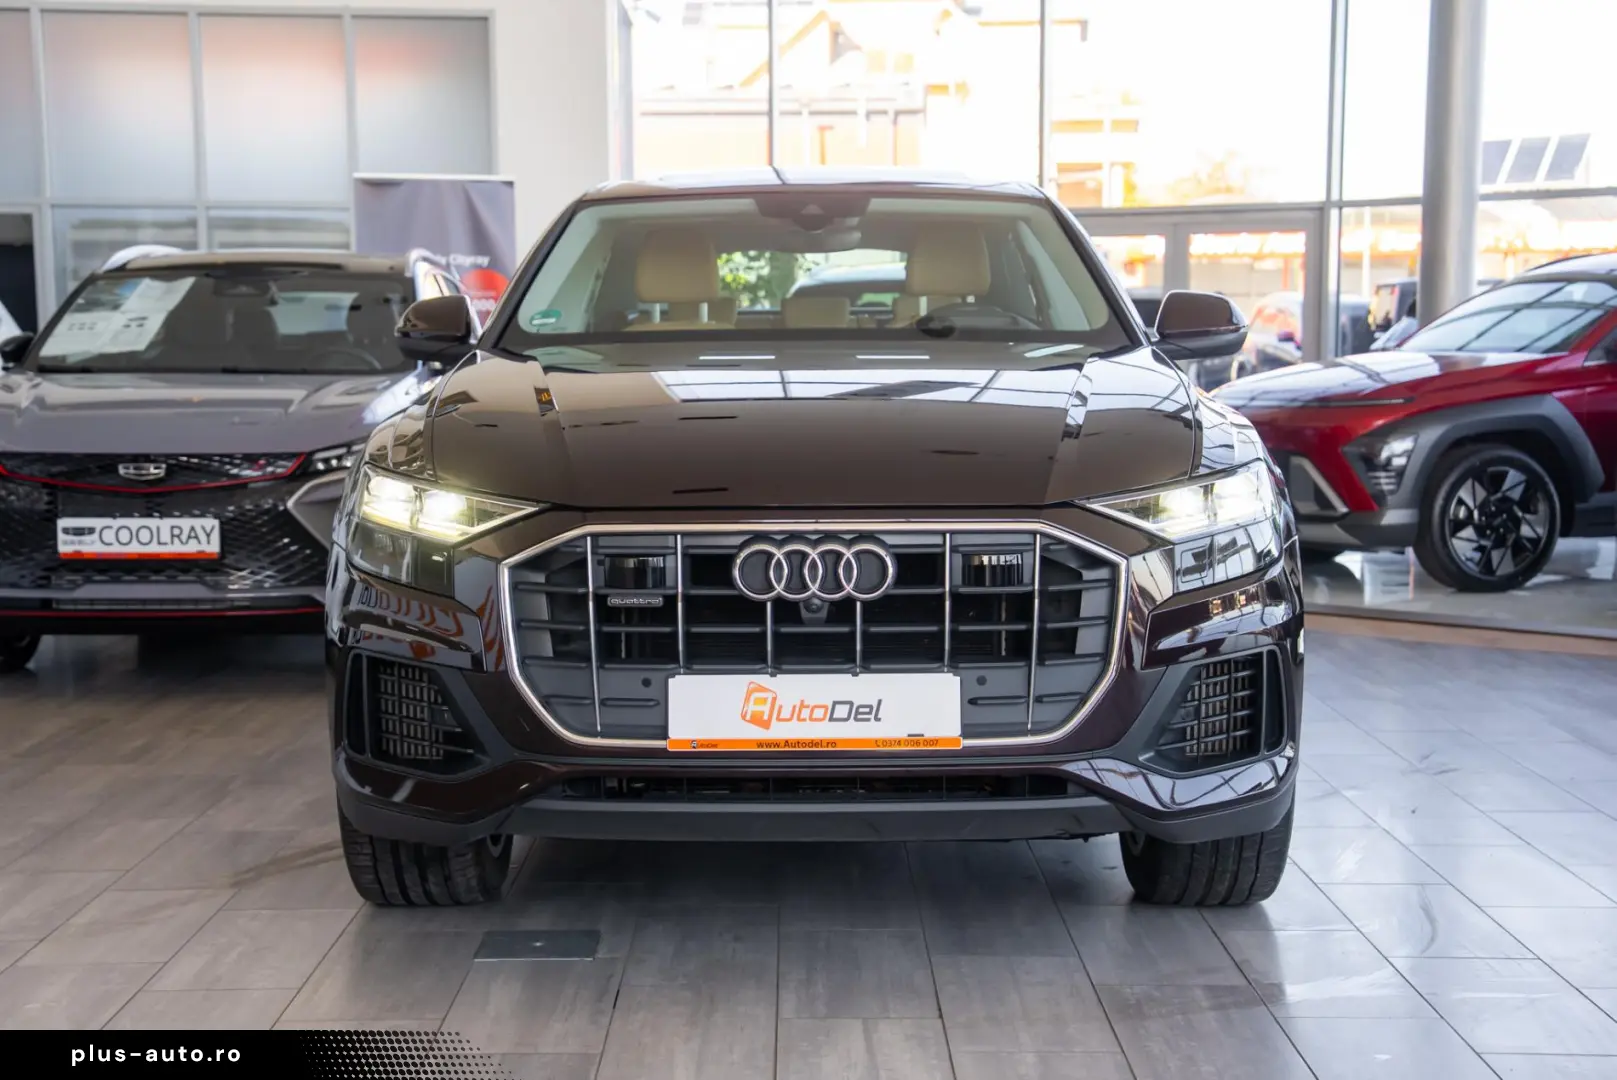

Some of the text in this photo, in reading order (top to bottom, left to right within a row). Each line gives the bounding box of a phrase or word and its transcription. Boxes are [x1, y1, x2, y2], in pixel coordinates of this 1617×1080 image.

[99, 525, 216, 546] COOLRAY
[609, 597, 660, 605] quattro
[741, 680, 883, 731] AutoDel
[756, 740, 837, 749] www.Autodel.ro
[881, 738, 902, 748] 0374
[903, 738, 921, 748] 006
[922, 738, 940, 747] 007
